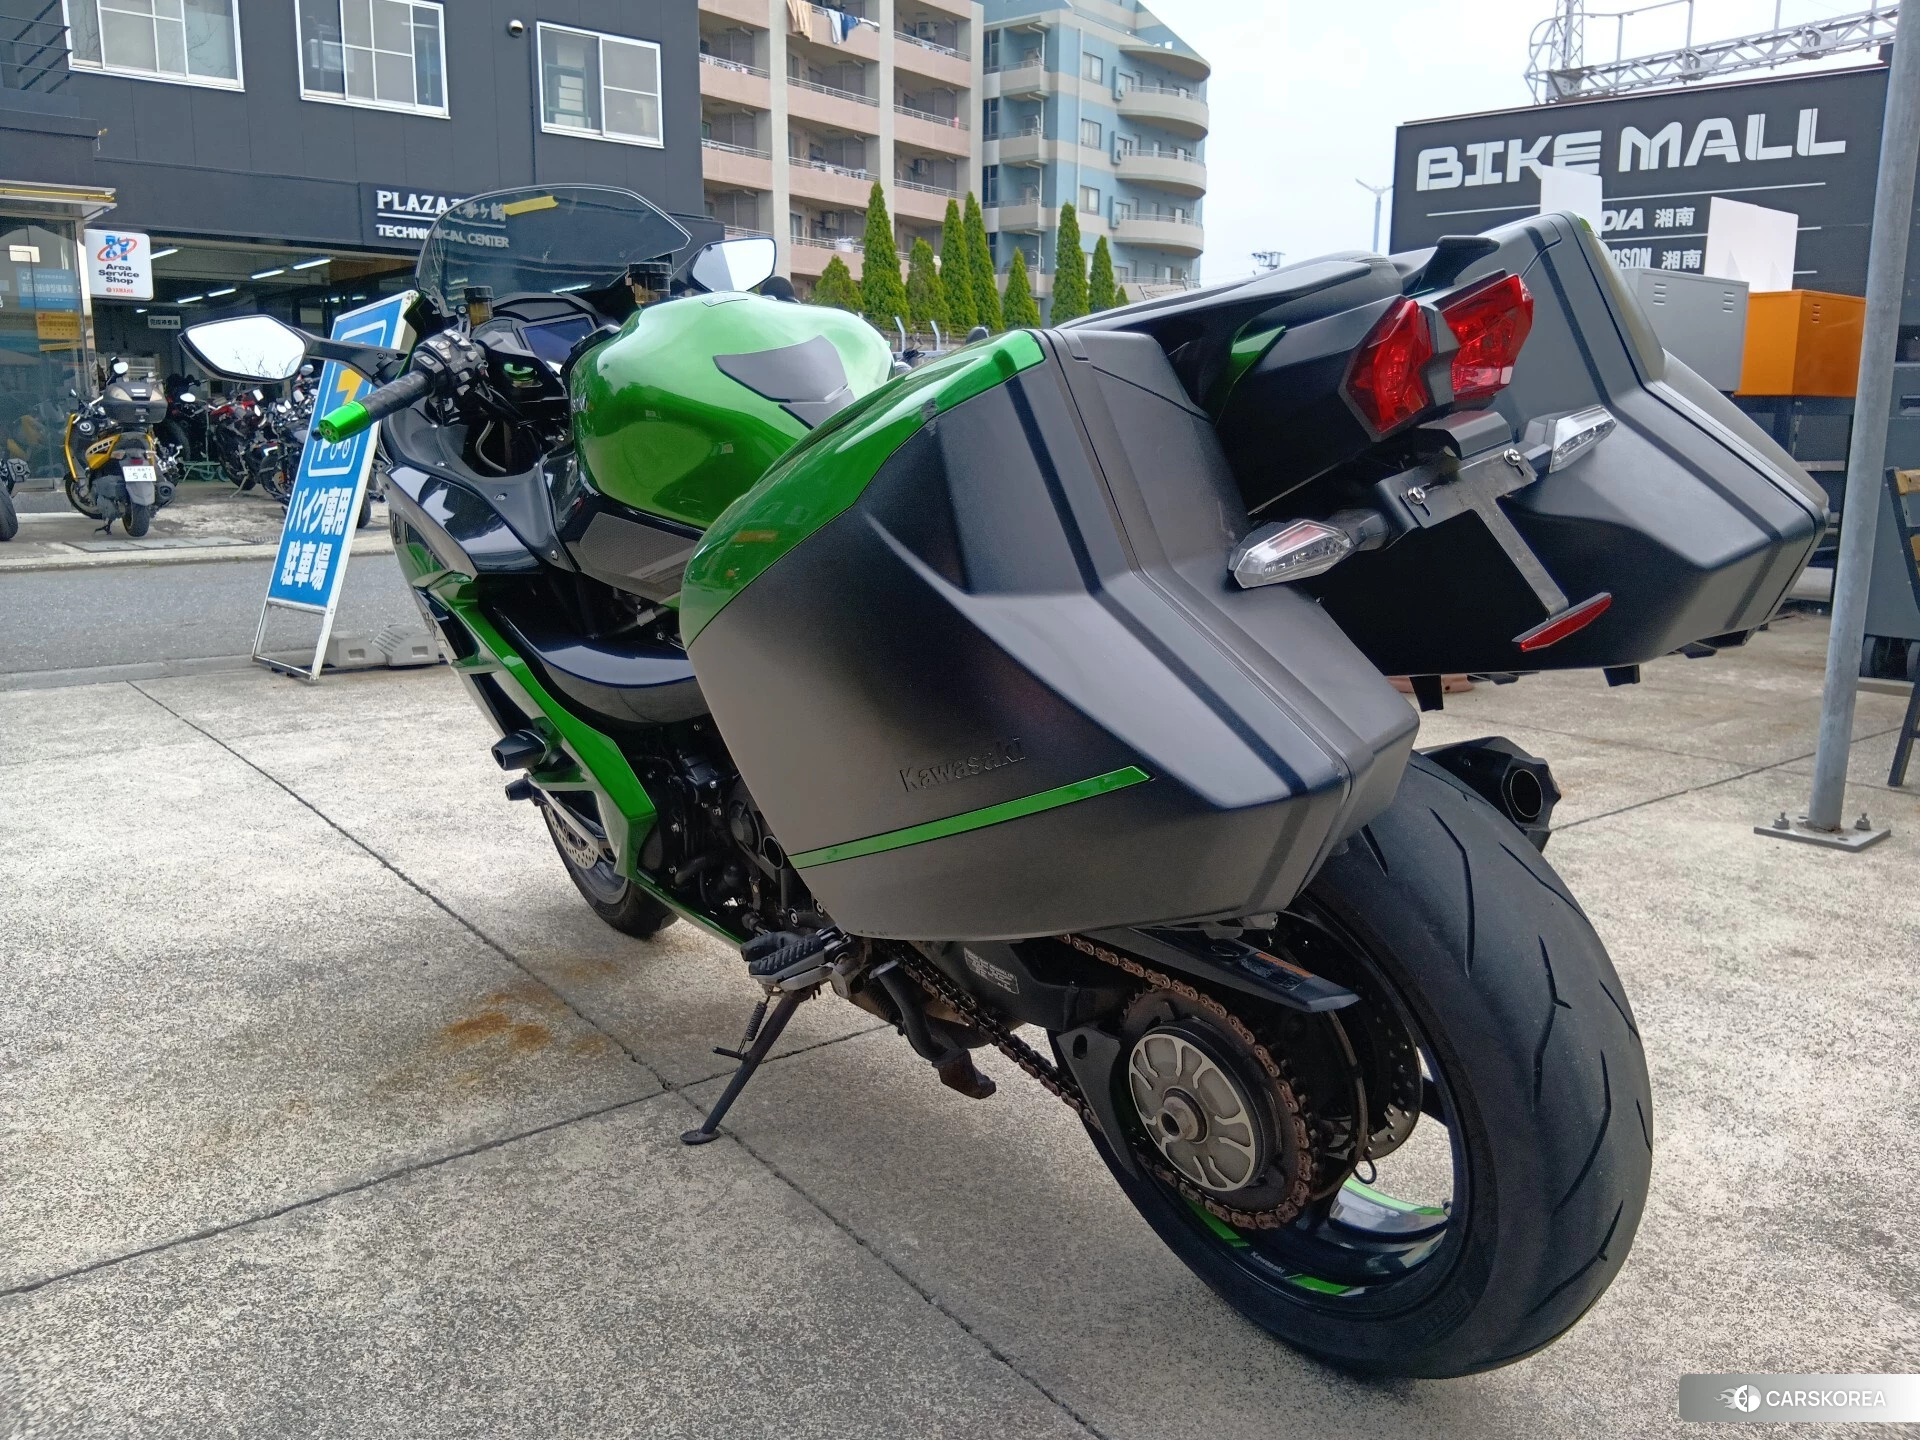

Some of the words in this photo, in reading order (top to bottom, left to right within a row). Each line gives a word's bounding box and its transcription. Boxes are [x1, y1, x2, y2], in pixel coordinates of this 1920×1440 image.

[1416, 129, 1602, 192] BIKE
[1618, 108, 1846, 173] MALL
[376, 189, 448, 214] PLAZA
[1654, 206, 1696, 228] 湘南
[467, 232, 510, 248] CENTER
[105, 263, 132, 271] Area
[1661, 249, 1702, 270] 湘南
[98, 269, 140, 278] Service
[105, 276, 134, 285] Shop
[288, 486, 354, 536] バイク専用
[280, 539, 333, 591] 駐車場
